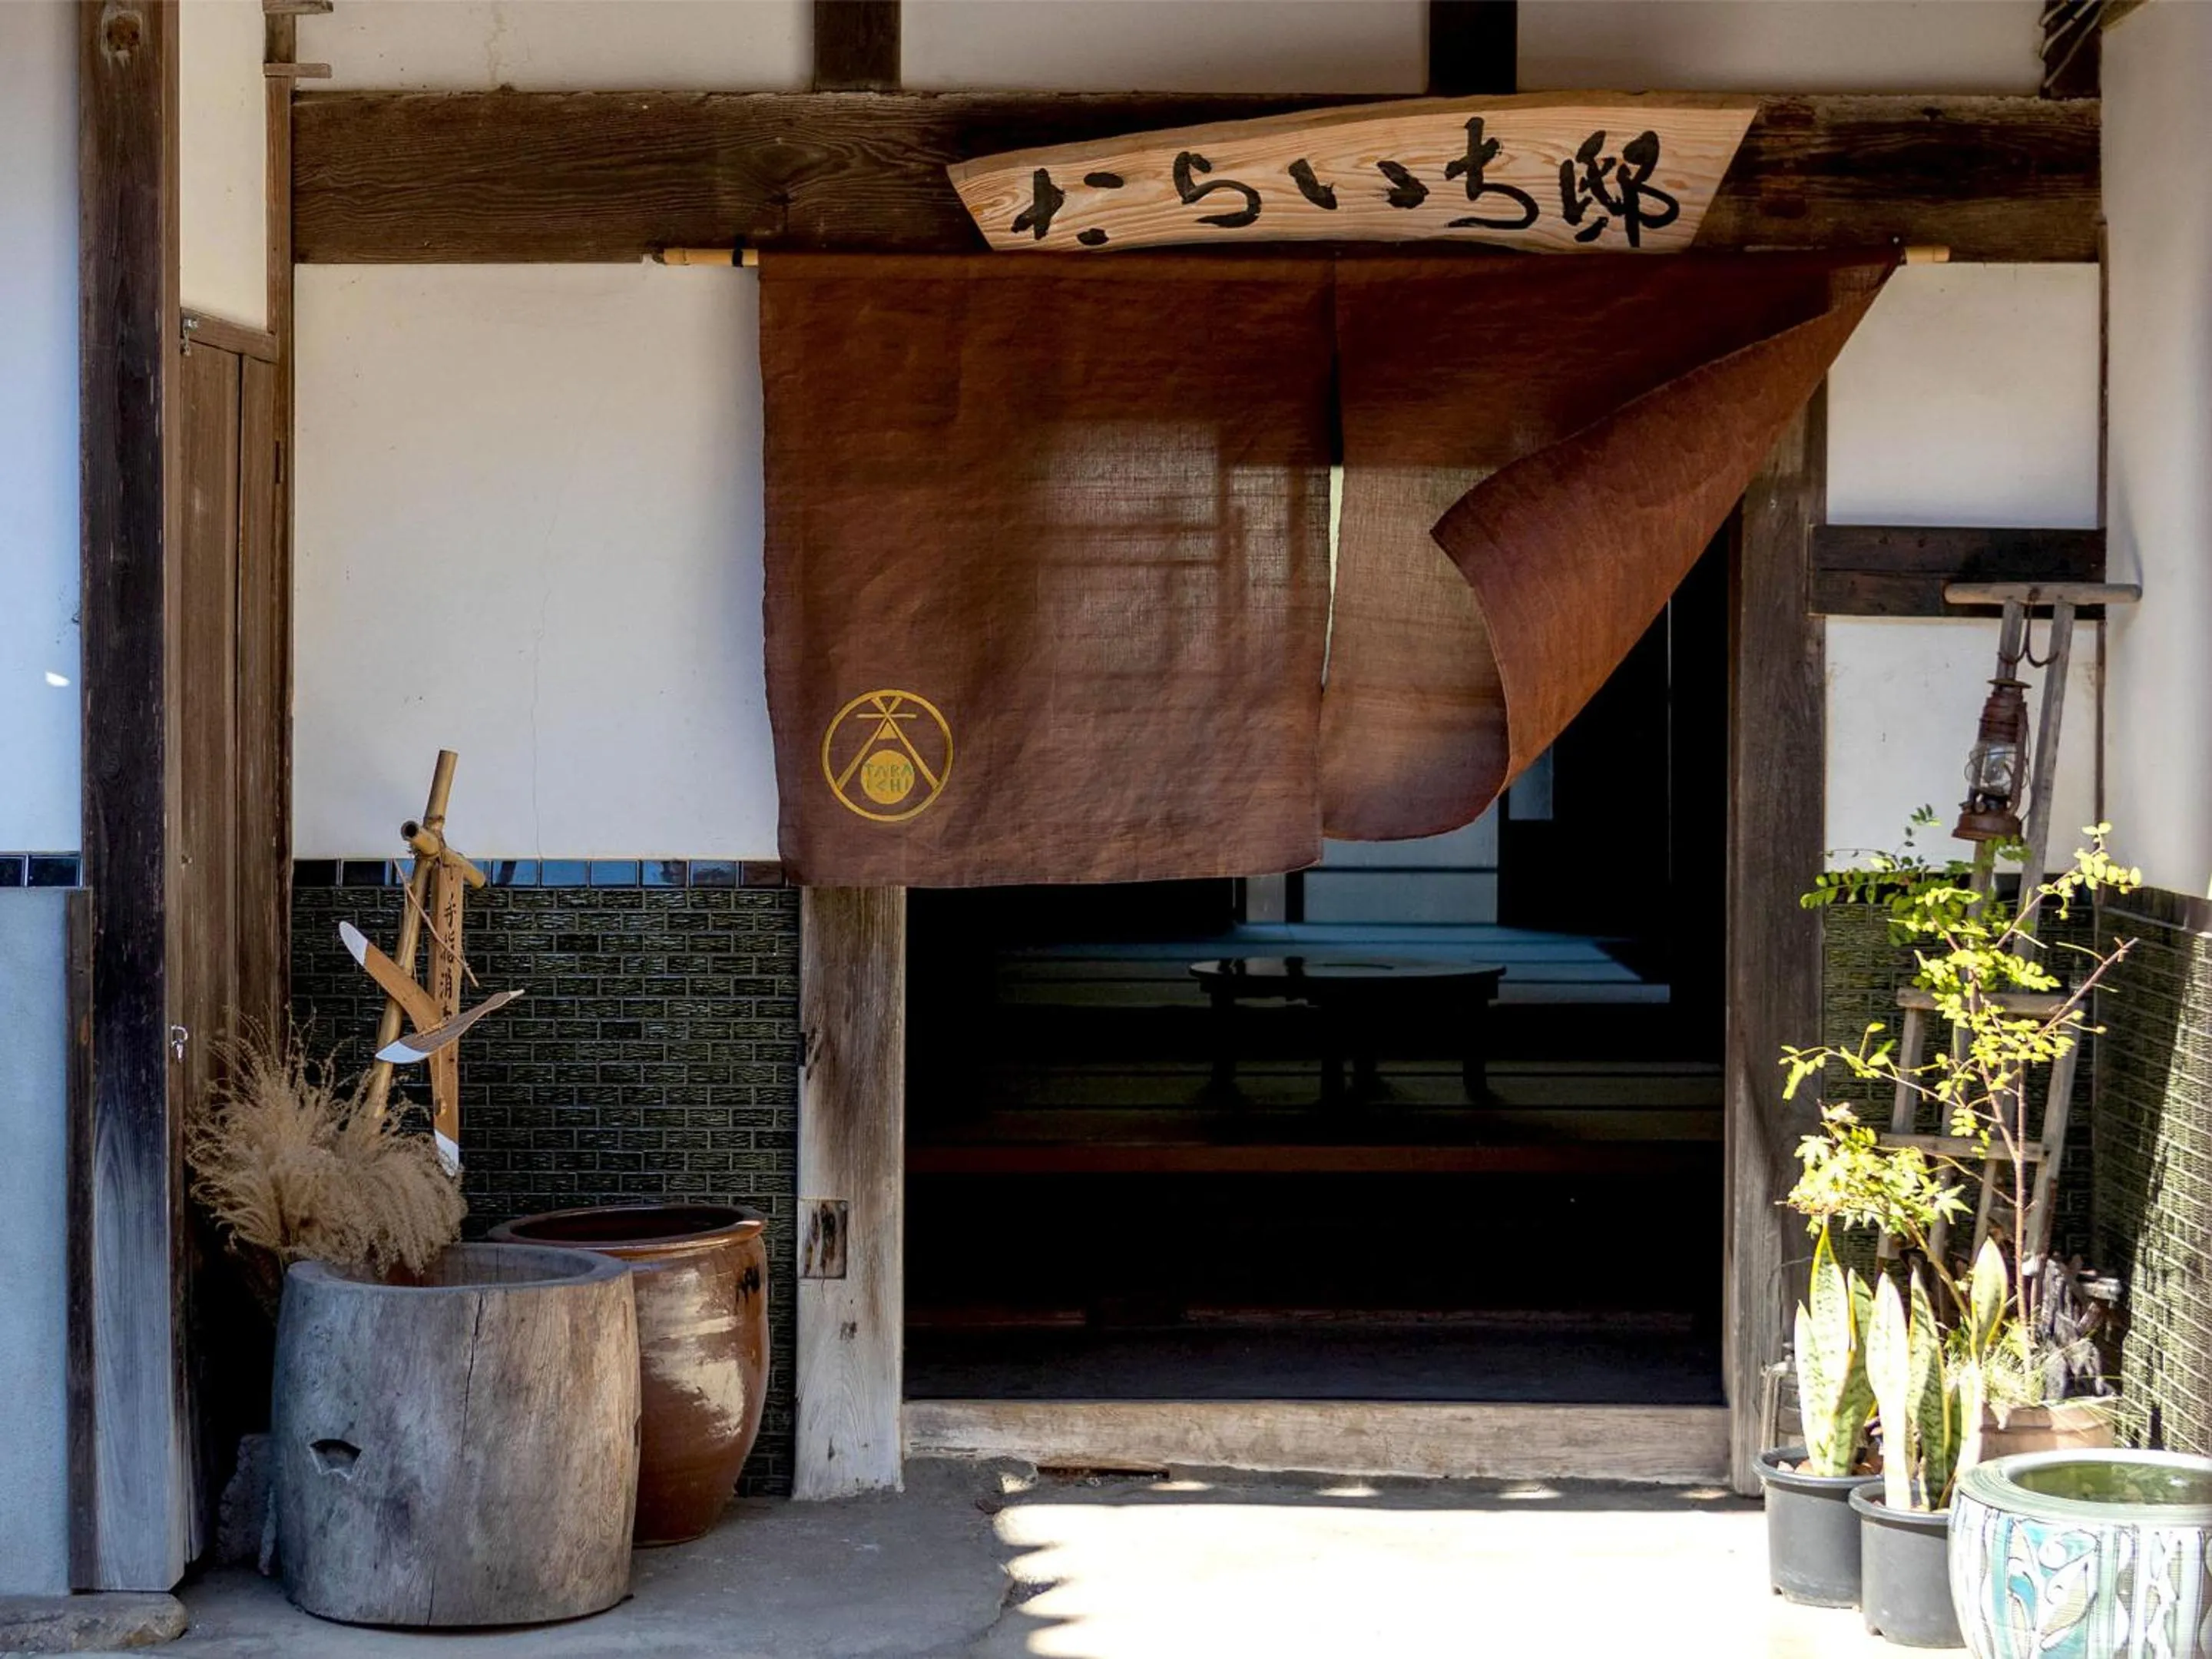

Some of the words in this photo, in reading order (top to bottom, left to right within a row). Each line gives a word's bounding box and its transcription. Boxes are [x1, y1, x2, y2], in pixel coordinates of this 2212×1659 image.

[1010, 115, 1680, 247] たらいち邸
[864, 763, 913, 777] TARA
